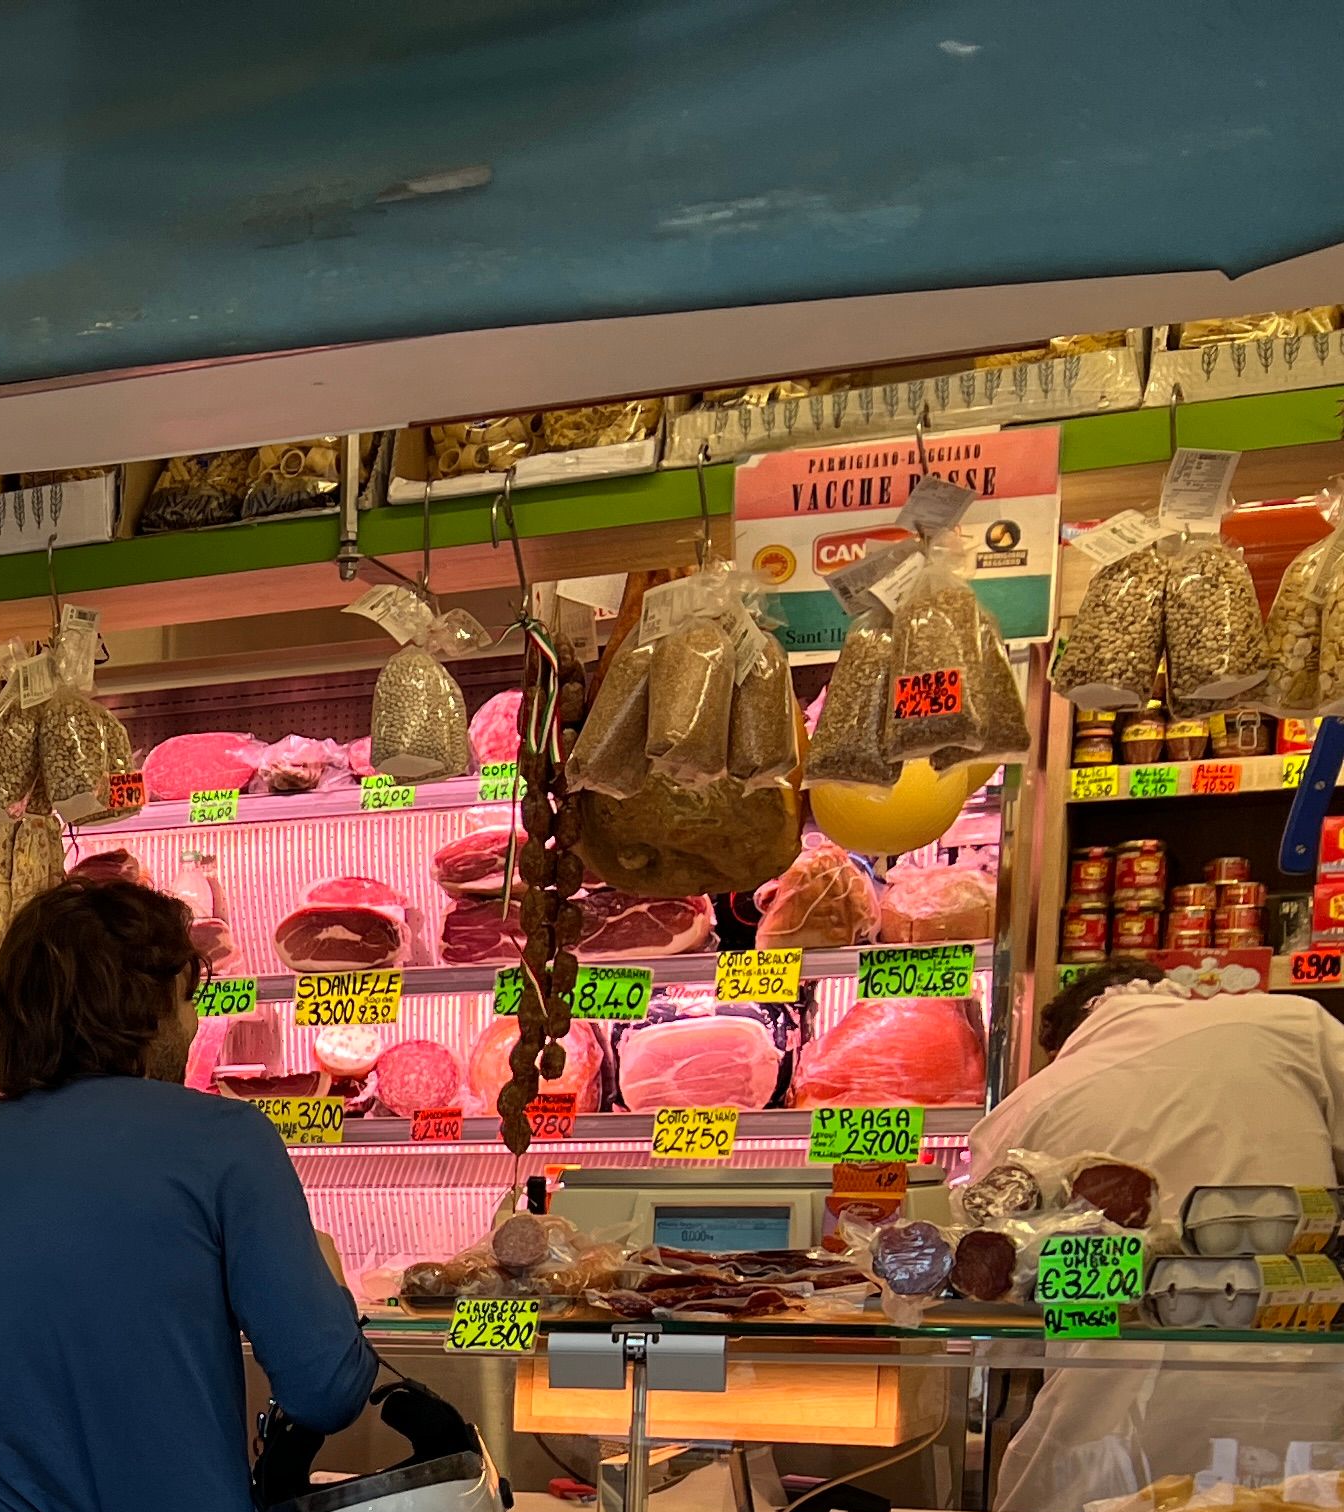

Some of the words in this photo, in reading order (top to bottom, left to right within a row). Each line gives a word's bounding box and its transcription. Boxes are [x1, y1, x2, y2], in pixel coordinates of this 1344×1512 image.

[791, 475, 893, 511] VACCHE
[898, 671, 959, 692] FARRO
[1076, 768, 1109, 779] ALICI
[1135, 768, 1171, 779] ALICI
[859, 943, 975, 966] MORTADELLA
[656, 1108, 688, 1125] COTTO
[817, 1107, 911, 1131] PRAGA
[1040, 1236, 1142, 1257] LONZINO
